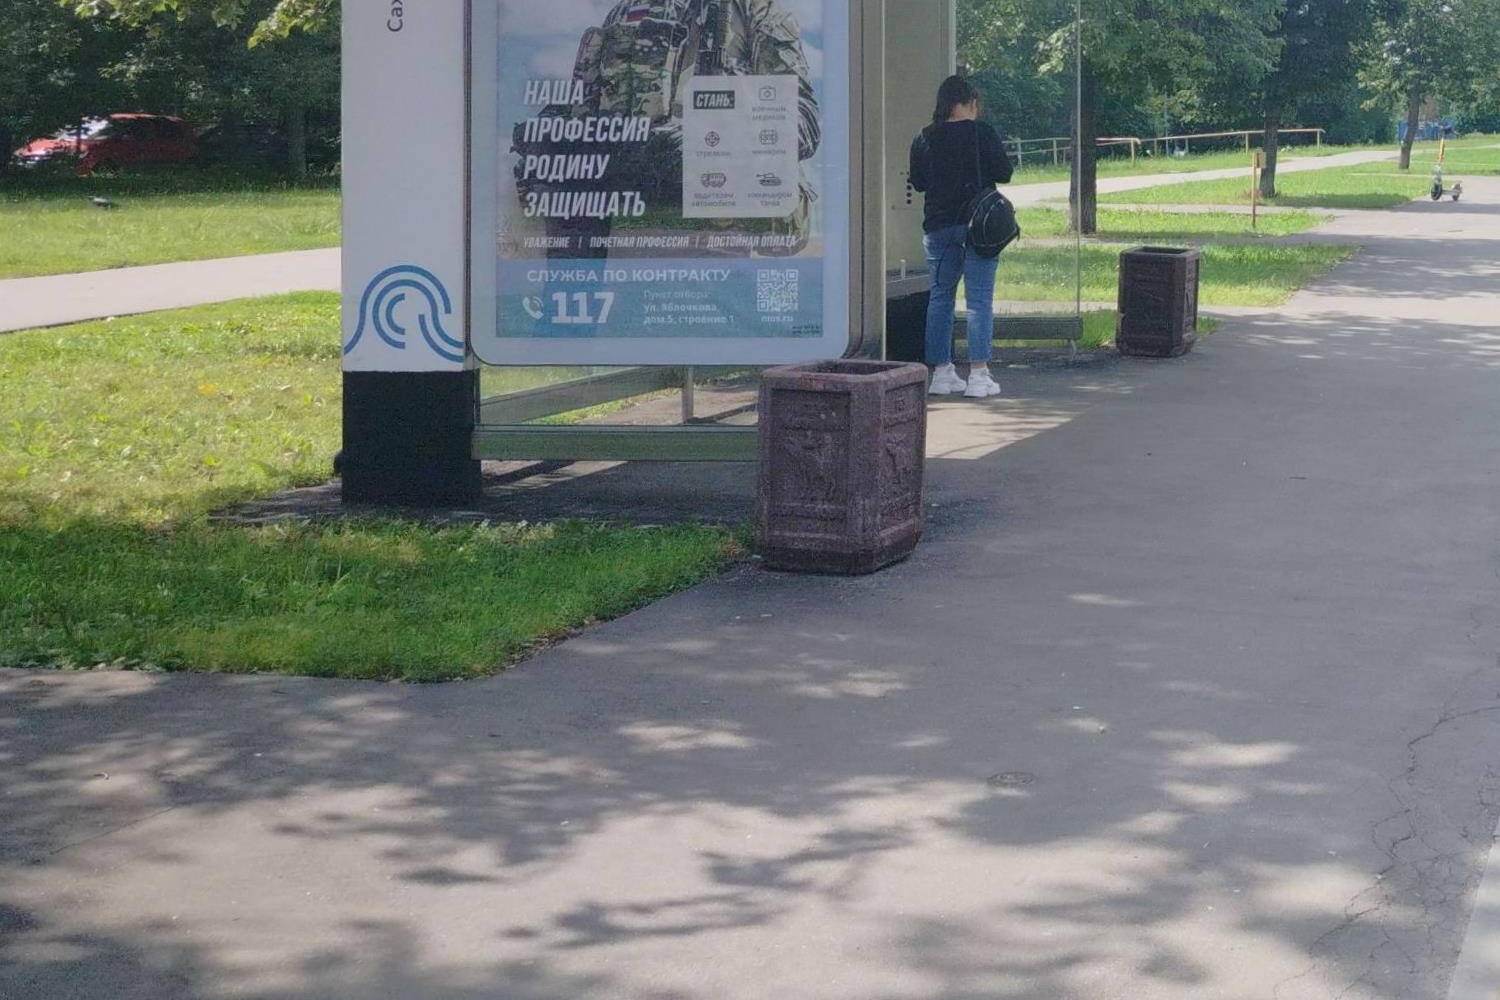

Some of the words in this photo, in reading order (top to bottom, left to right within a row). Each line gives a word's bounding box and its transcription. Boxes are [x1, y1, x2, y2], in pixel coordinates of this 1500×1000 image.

[523, 79, 585, 105] НАША
[523, 115, 651, 142] ПРОФЕССИЯ
[523, 153, 611, 183] РОДИНУ
[523, 190, 647, 220] ЗАЩИЩАТЬ
[523, 236, 571, 248] УВАЖЕНИЕ
[636, 236, 689, 248] ПРОФЕССИЯ
[707, 234, 760, 248] ДОСТОЙНАЯ
[760, 235, 796, 248] ОПЛАТА
[526, 268, 598, 282] СЛУЖБА
[603, 268, 628, 282] ПО
[631, 268, 731, 282] КОНТРАКТУ
[551, 291, 615, 324] 117
